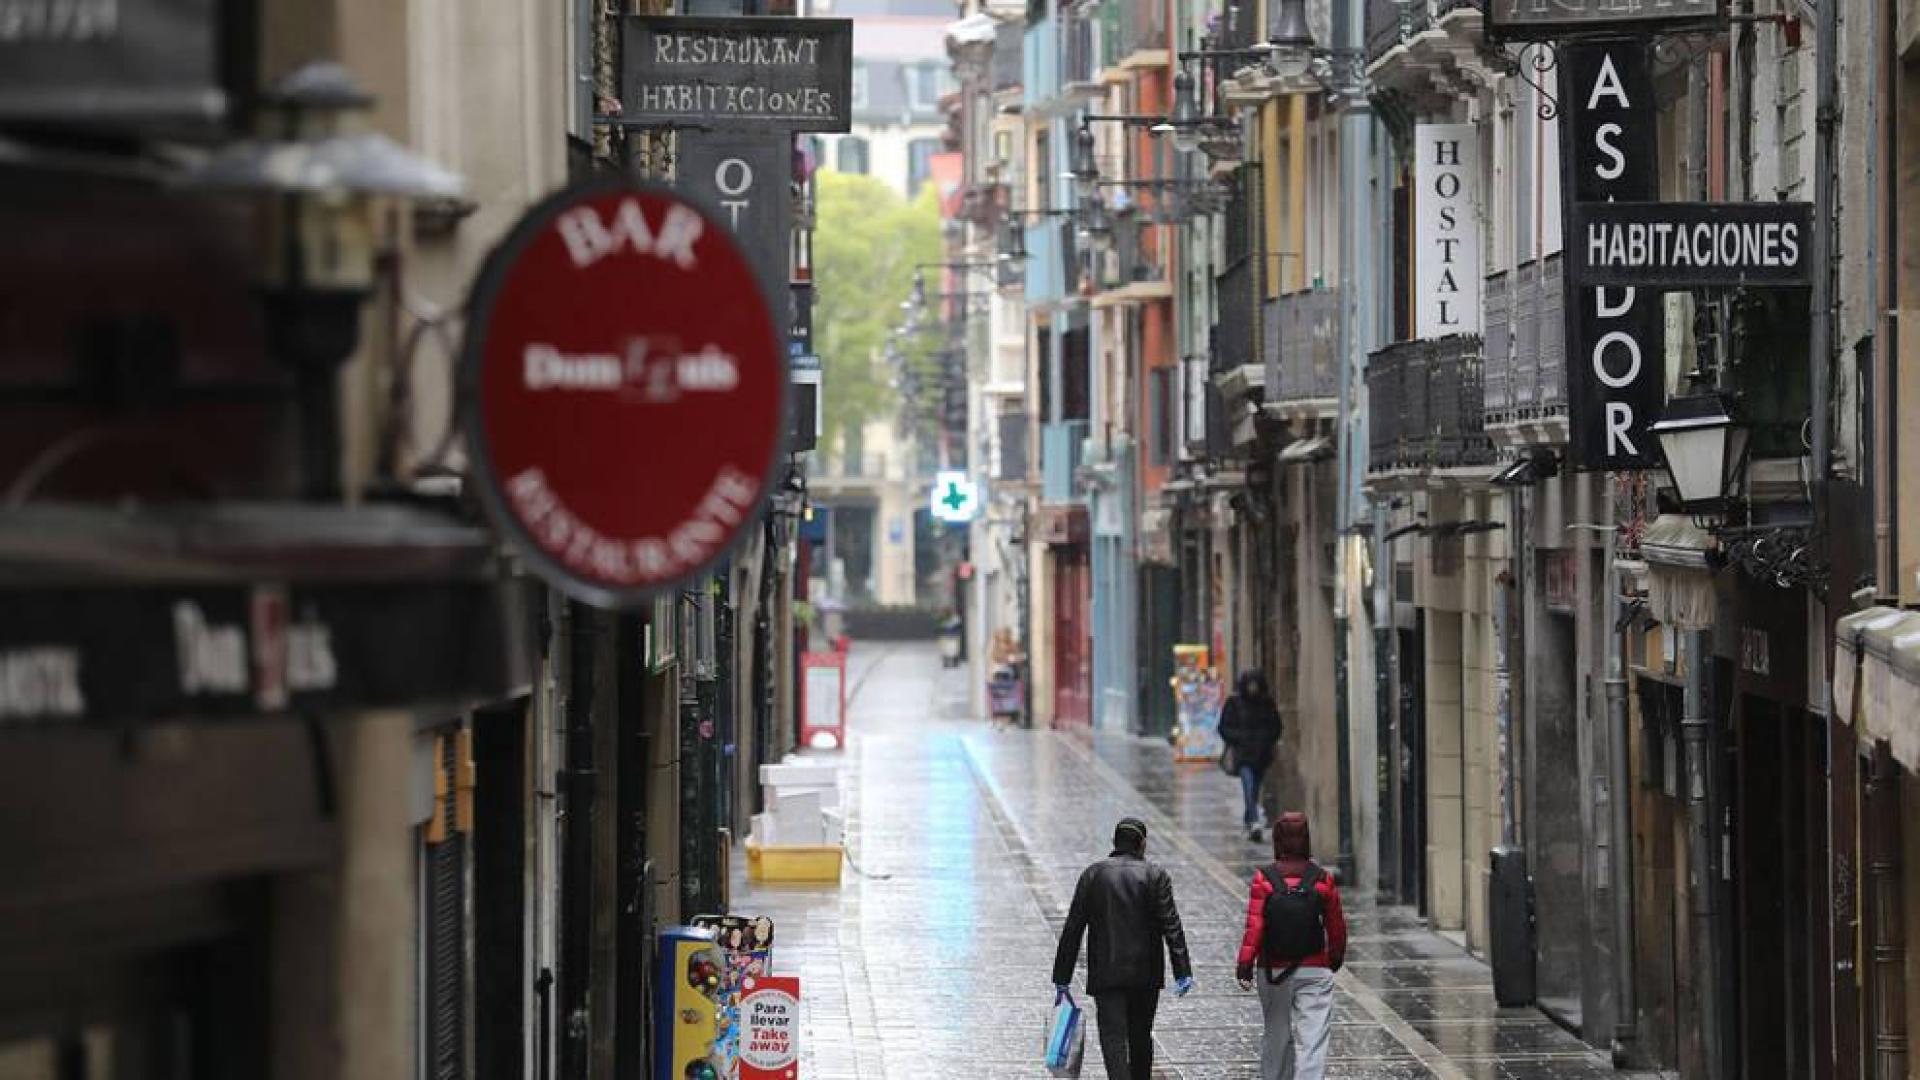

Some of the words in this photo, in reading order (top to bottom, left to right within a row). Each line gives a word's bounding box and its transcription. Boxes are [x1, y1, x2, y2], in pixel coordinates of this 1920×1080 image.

[655, 34, 819, 64] RESTAURANT
[643, 85, 831, 114] HABITACIONES
[714, 158, 753, 233] OT
[556, 198, 704, 269] BAR
[1434, 140, 1460, 325] HOSTAL
[1588, 222, 1799, 266] HABITACIONES
[1587, 52, 1641, 456] ASDOR
[506, 467, 760, 585] RESTAURANTE
[750, 1015, 790, 1026] llevar
[754, 1002, 787, 1014] Para
[750, 1041, 790, 1053] away
[751, 1027, 788, 1039] Take
